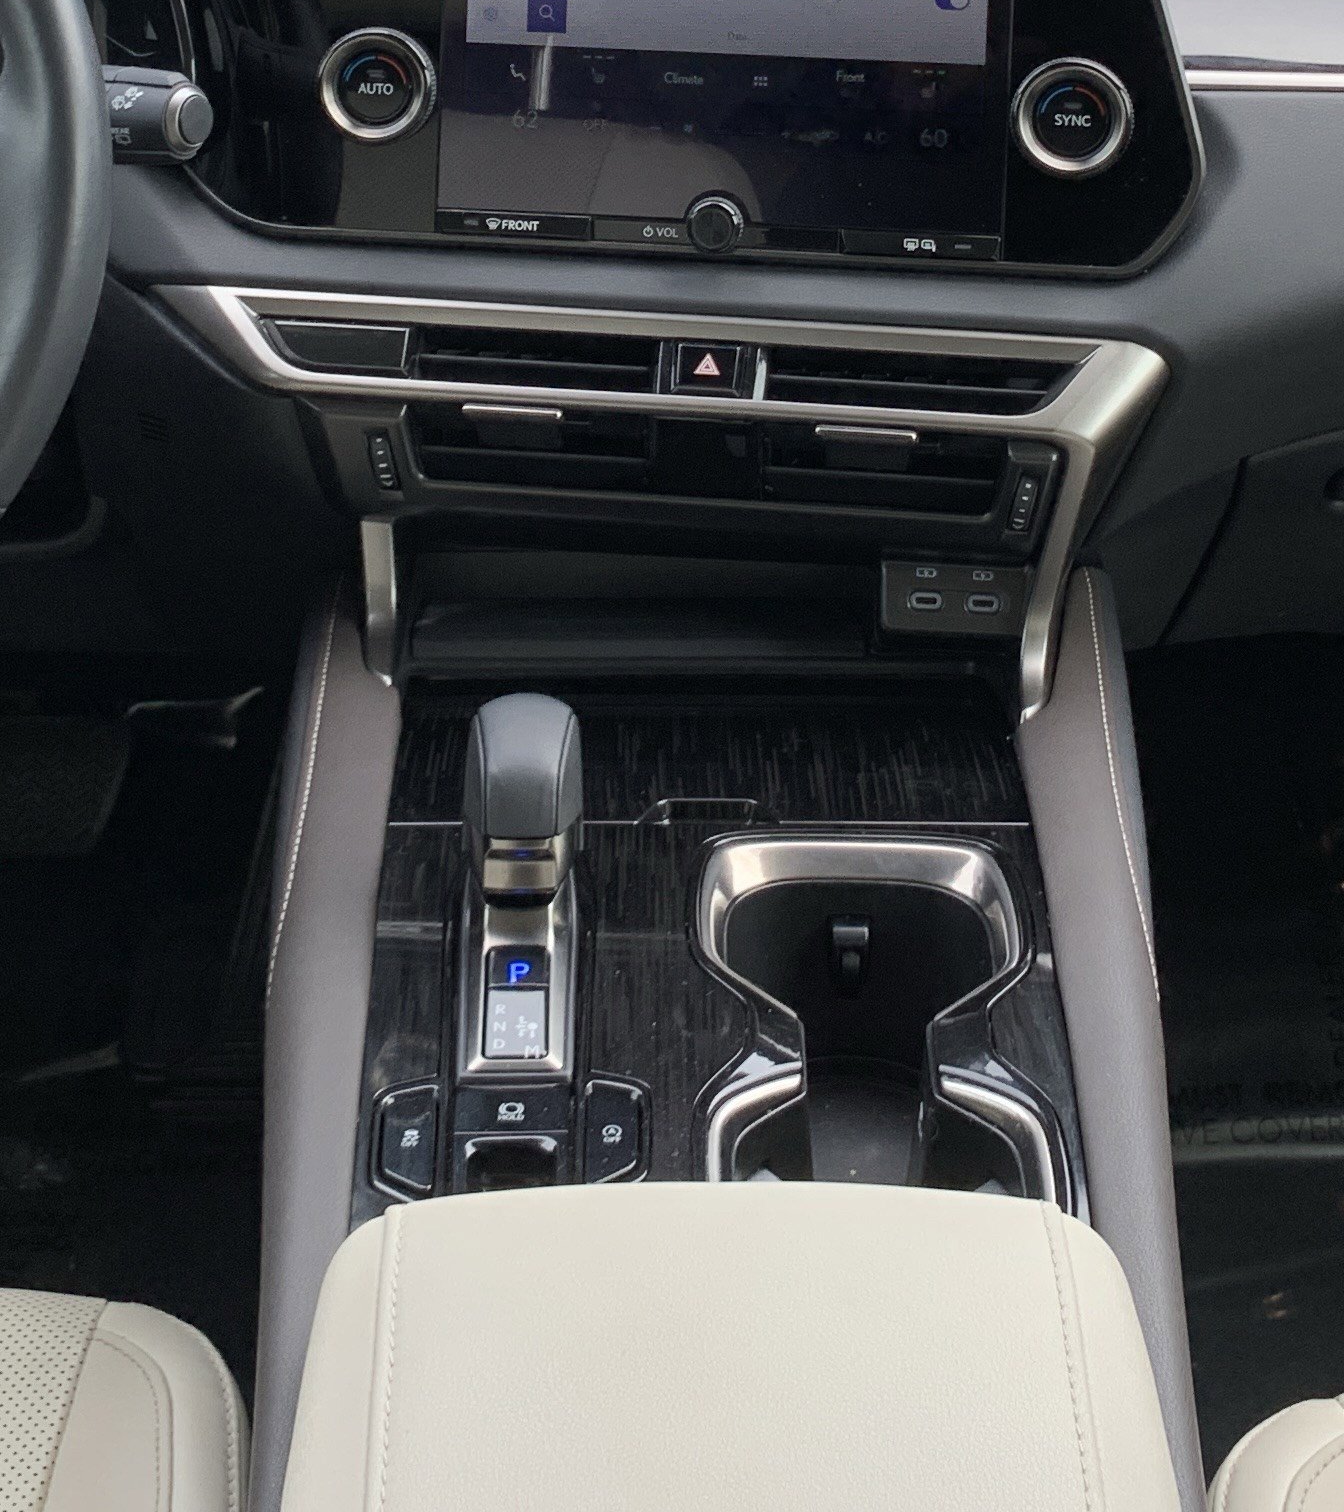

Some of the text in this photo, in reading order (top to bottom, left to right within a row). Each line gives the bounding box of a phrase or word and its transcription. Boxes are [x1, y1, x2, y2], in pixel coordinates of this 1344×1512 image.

[663, 70, 866, 87] Climate Front
[358, 83, 394, 96] AUTO
[512, 110, 539, 130] 62
[919, 128, 948, 148] 60
[1054, 113, 1093, 129] SYNC
[501, 219, 679, 239] FRONT VOL
[508, 962, 531, 984] P
[494, 1003, 507, 1016] R
[492, 1020, 507, 1033] N
[492, 1038, 542, 1059] D M
[496, 1112, 526, 1122] HOLD
[602, 1135, 622, 1146] OFF
